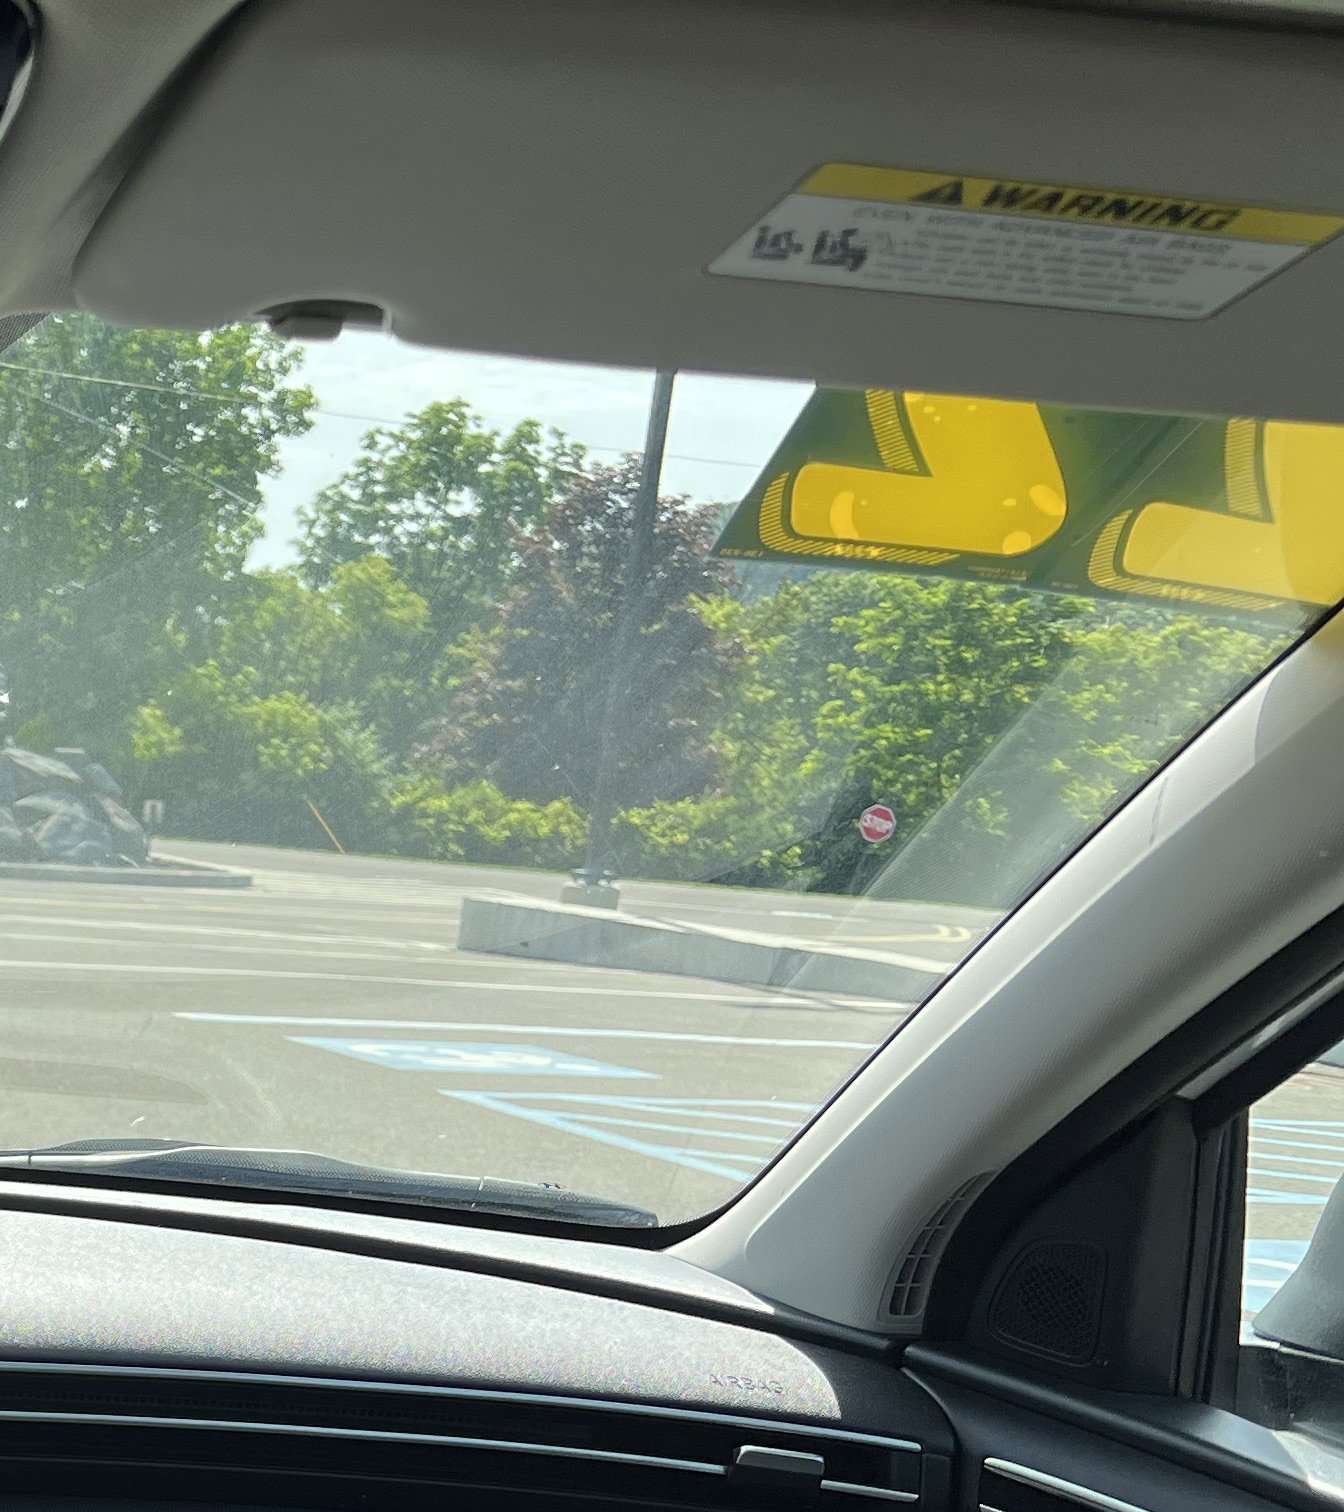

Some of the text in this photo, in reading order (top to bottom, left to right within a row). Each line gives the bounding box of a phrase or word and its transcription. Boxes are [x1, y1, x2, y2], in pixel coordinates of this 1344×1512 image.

[981, 183, 1243, 231] WARNING
[861, 813, 894, 833] STOP
[709, 1373, 784, 1394] AIRBAG
